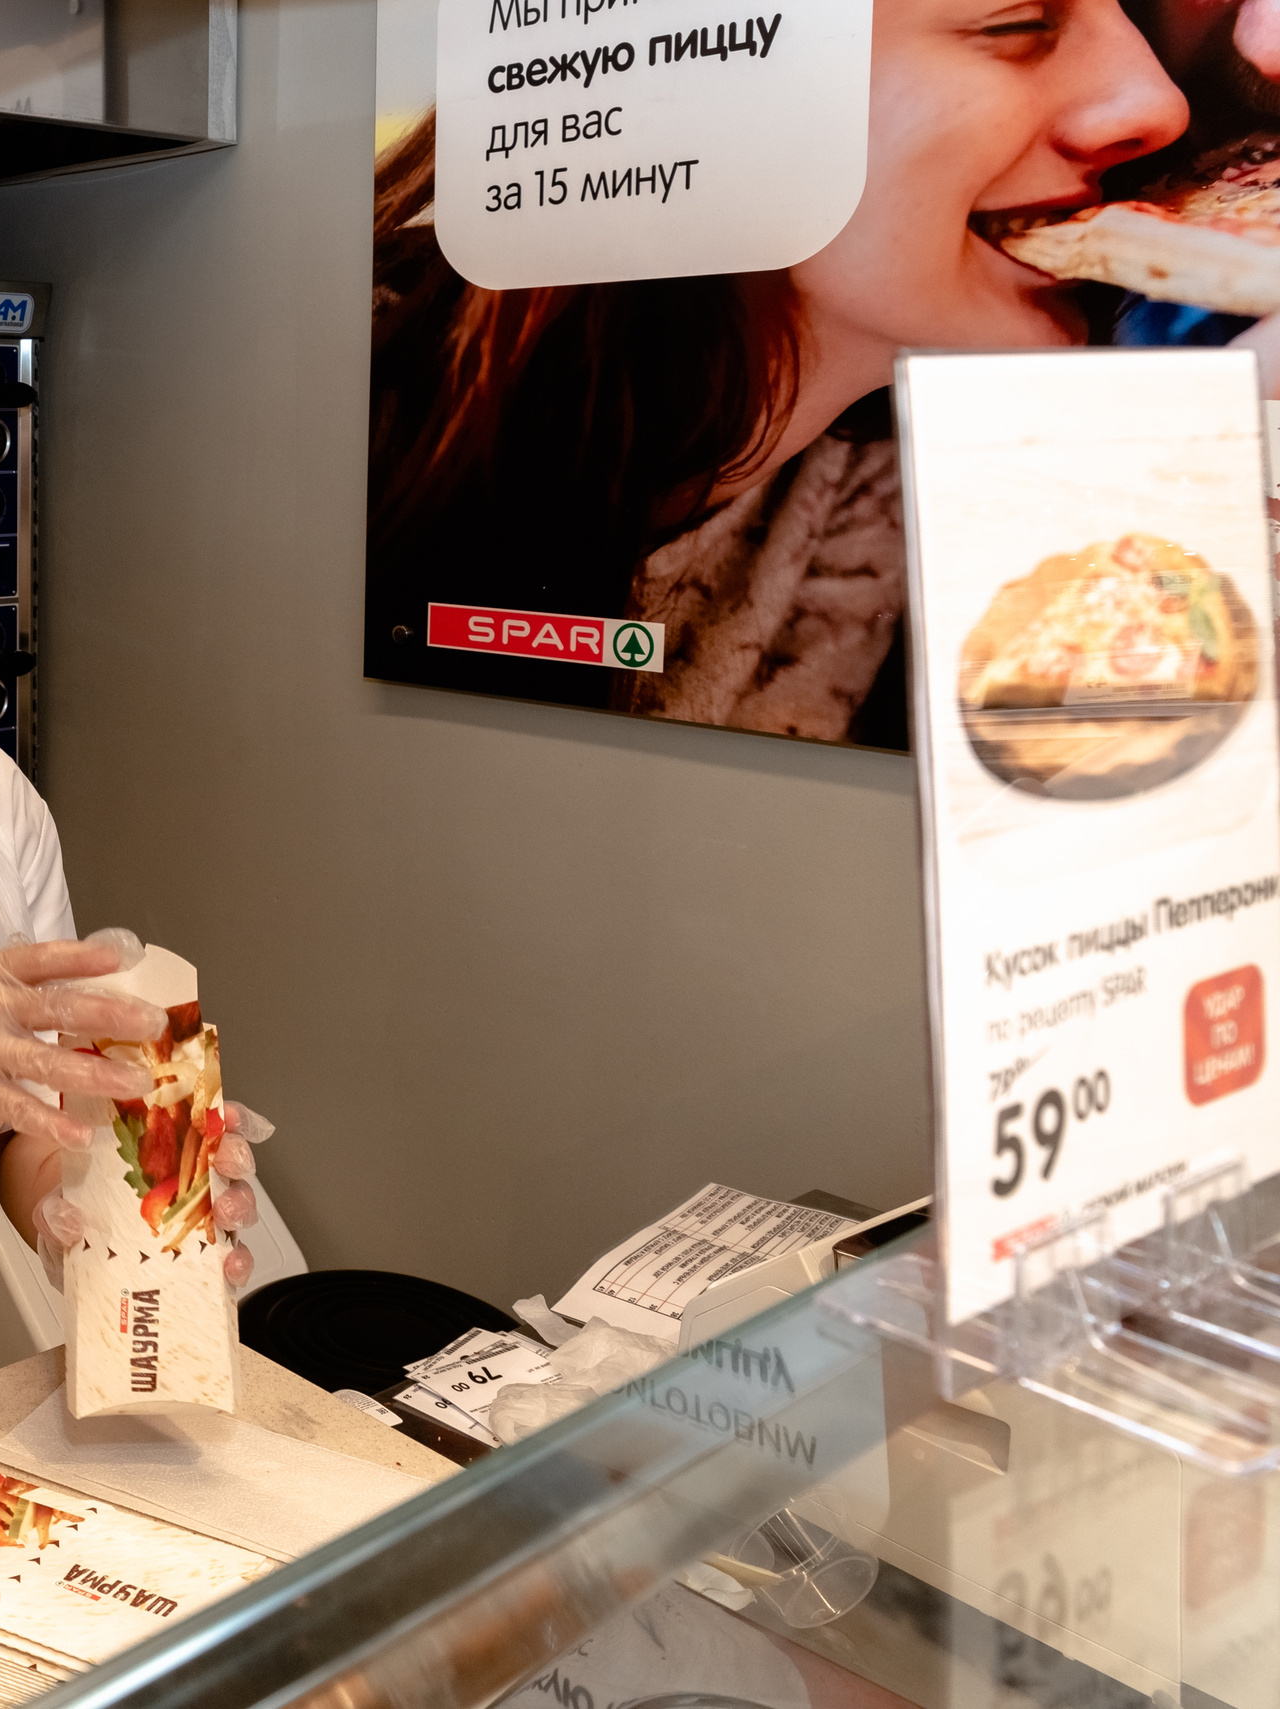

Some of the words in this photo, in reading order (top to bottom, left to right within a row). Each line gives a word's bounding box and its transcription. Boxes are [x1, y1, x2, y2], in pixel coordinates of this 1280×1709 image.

[488, 42, 635, 93] свежую
[648, 13, 782, 66] пиццу
[486, 118, 548, 161] для
[561, 107, 623, 142] вас
[485, 182, 521, 212] за
[534, 168, 568, 207] 15
[581, 159, 699, 204] минут
[468, 616, 600, 655] SPAR
[983, 942, 1059, 991] Кусок
[1066, 912, 1149, 959] пиццы
[990, 1088, 1067, 1198] 59
[1073, 1069, 1111, 1121] 00
[130, 1289, 160, 1392] ШАУРМА
[451, 1382, 470, 1392] 00
[467, 1366, 503, 1384] 79
[63, 1564, 178, 1617] ШАУРМА
